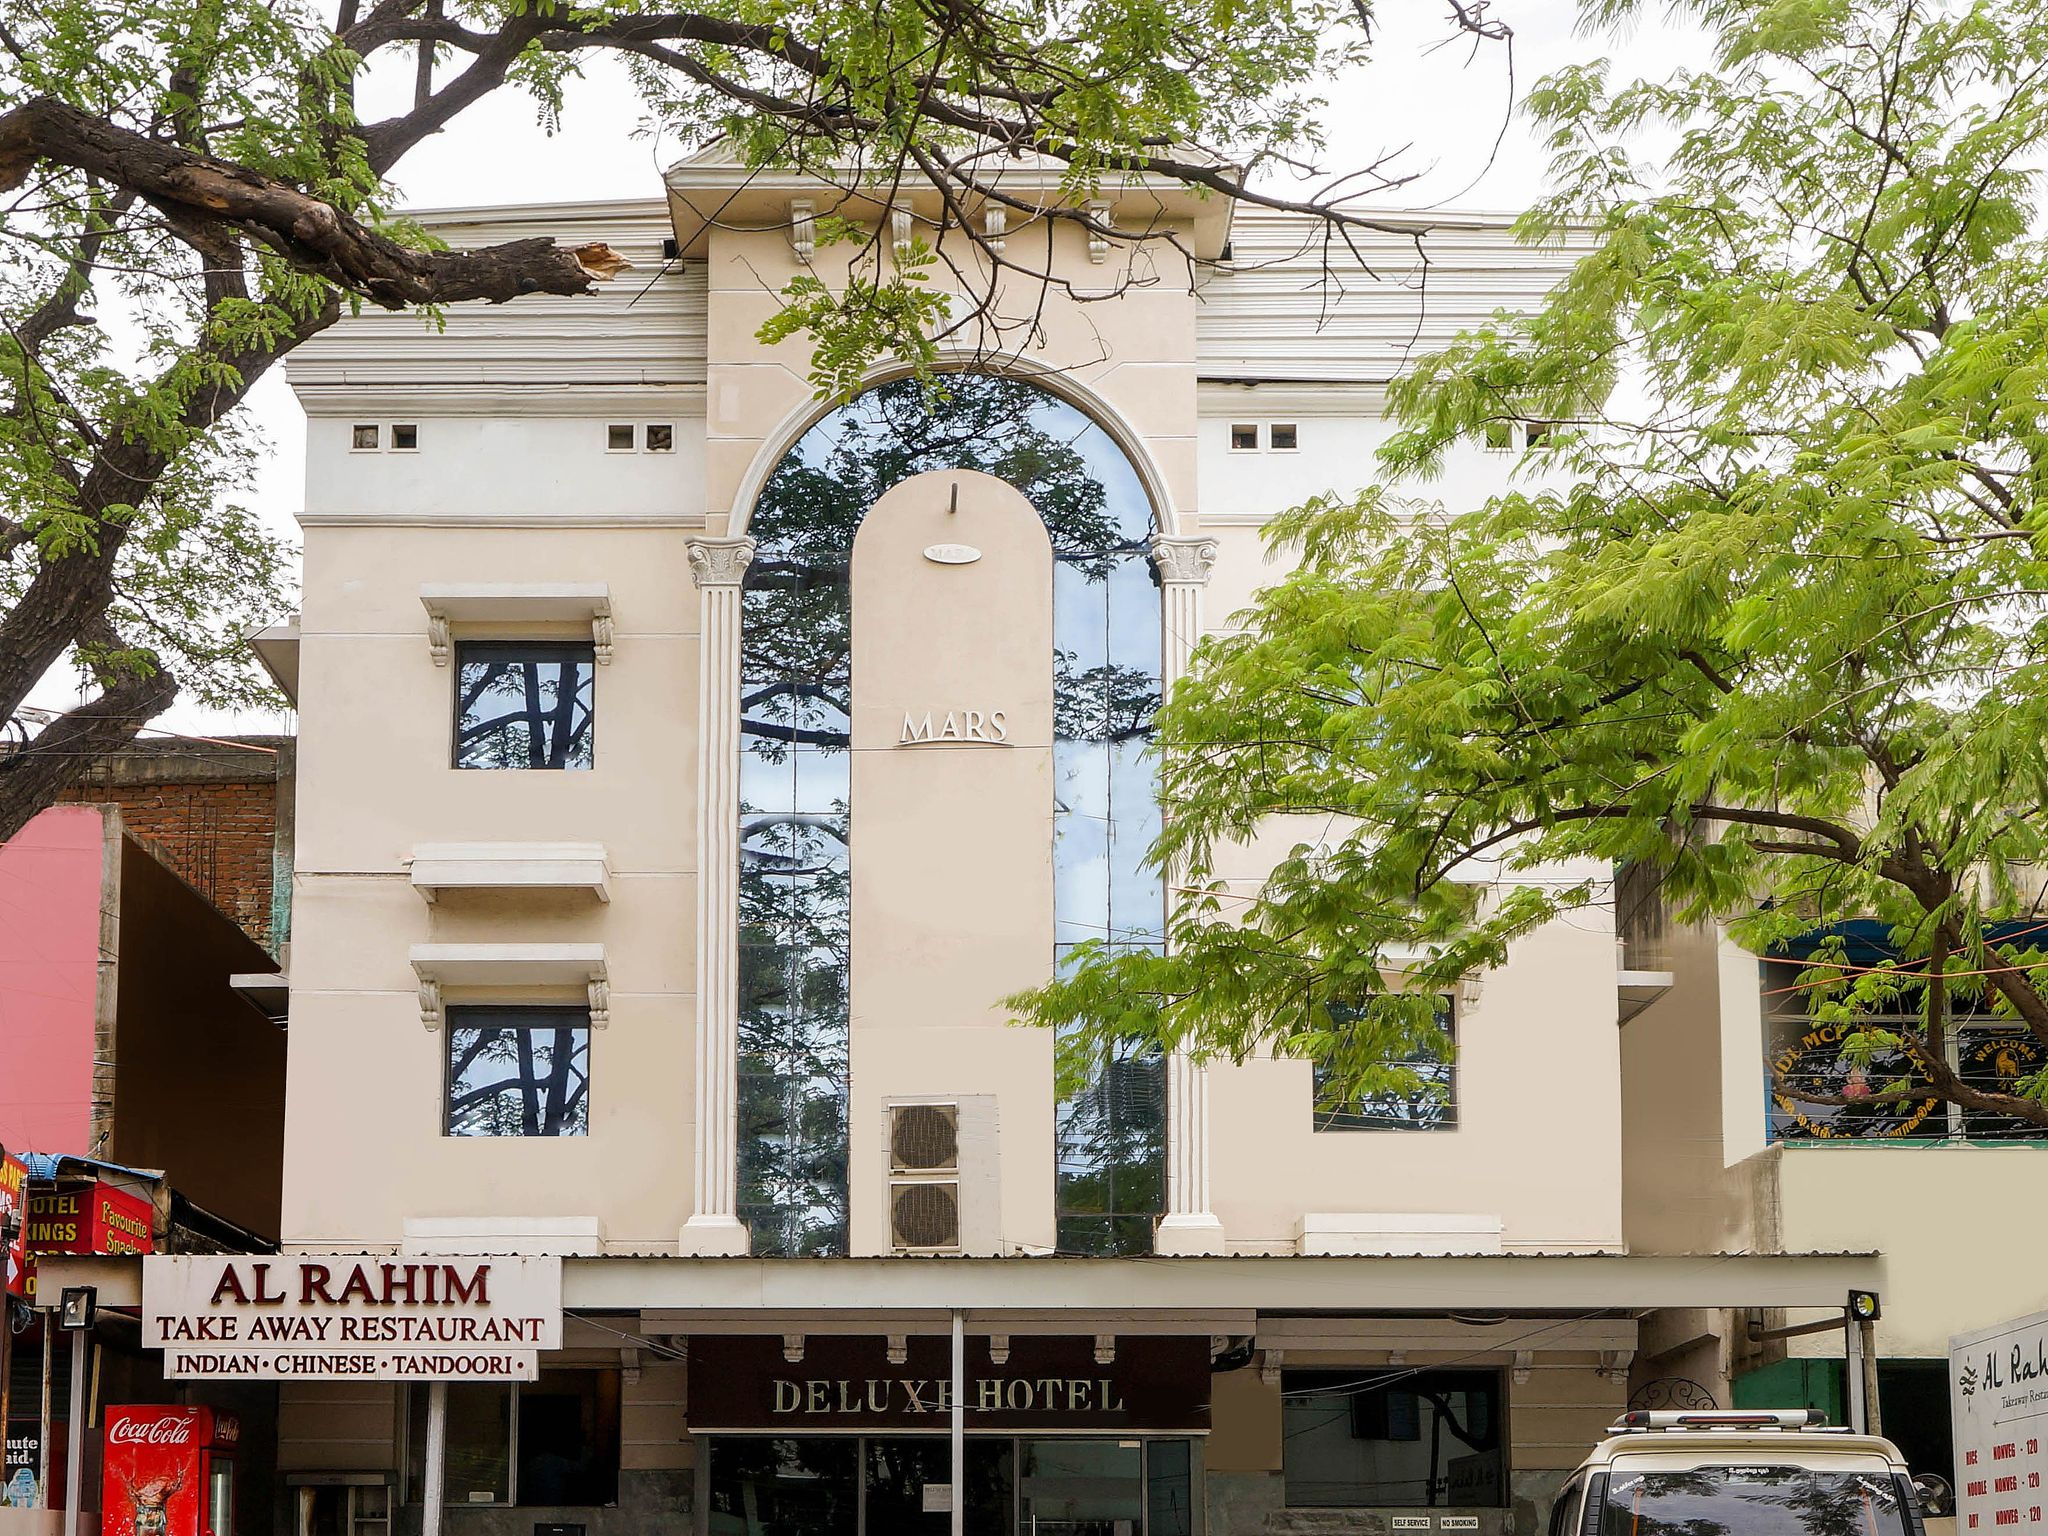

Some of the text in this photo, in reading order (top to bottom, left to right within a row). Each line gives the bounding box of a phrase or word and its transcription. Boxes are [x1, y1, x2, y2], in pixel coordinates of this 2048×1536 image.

[899, 711, 1008, 741] MARS
[1975, 1039, 2037, 1062] WELCOME
[102, 1201, 147, 1239] Favourite
[211, 1263, 492, 1305] AL RAHIM
[156, 1316, 545, 1342] TAKE AWAY RESTAURANT
[176, 1355, 512, 1374] INDIAN CHINESE TANDOORI
[773, 1379, 1127, 1413] DELUXE HOTEL
[109, 1417, 194, 1443] Coca-Cola
[2026, 1438, 2038, 1455] 120
[1967, 1480, 1988, 1497] NOODLE
[2028, 1472, 2040, 1489] 120
[1393, 1519, 1429, 1527] SELF SERVICE
[1442, 1519, 1477, 1527] NO SMOKING
[2029, 1505, 2041, 1522] 120
